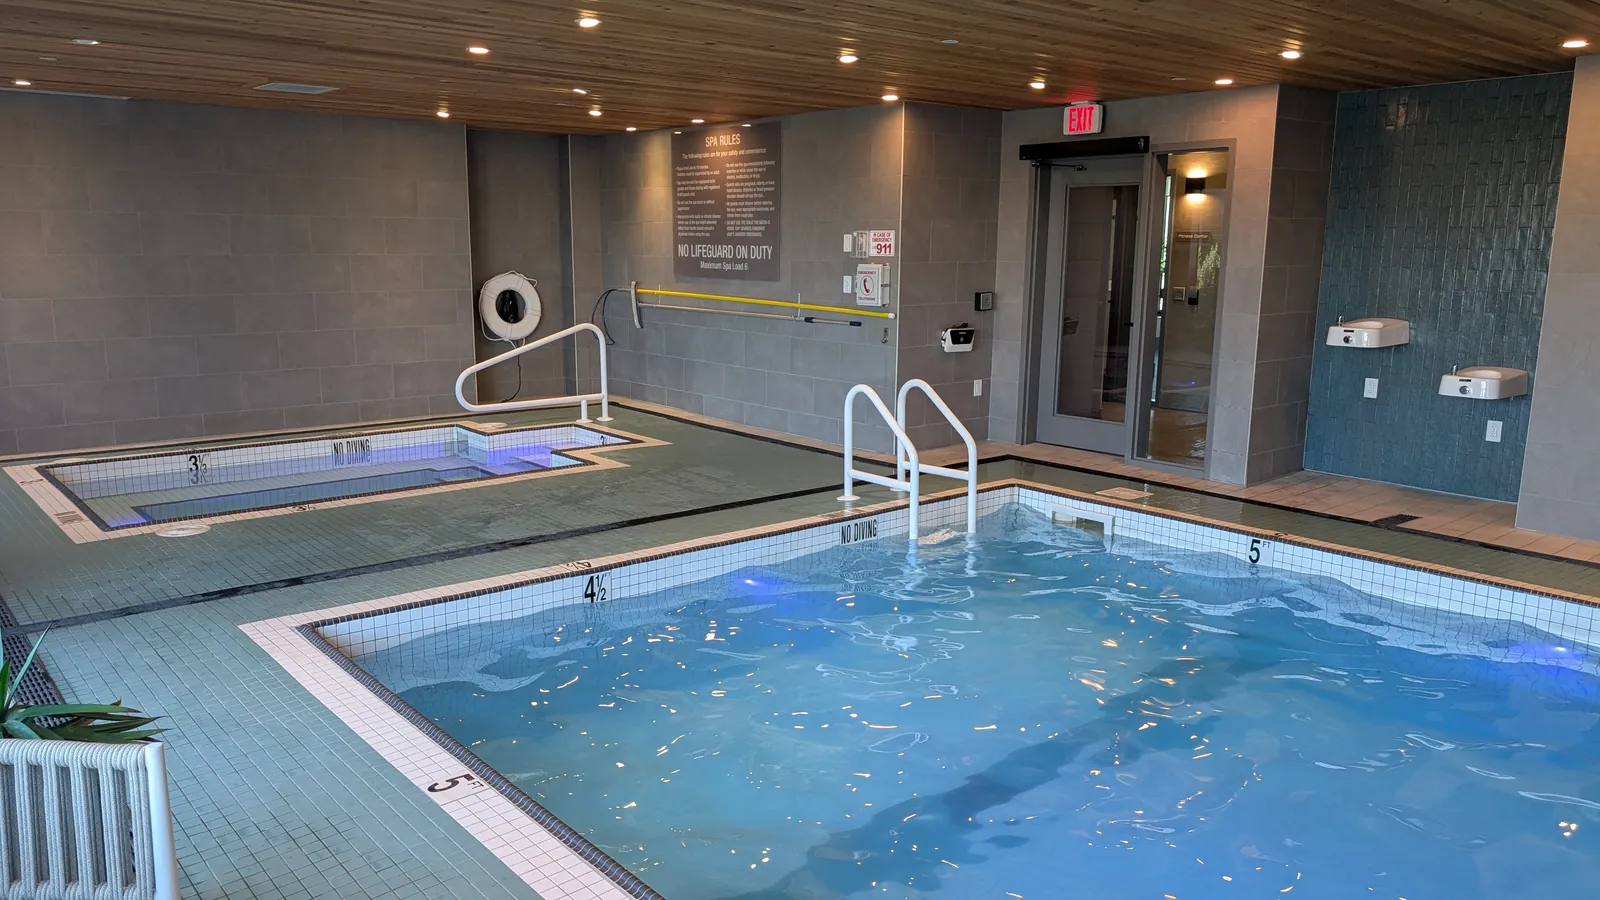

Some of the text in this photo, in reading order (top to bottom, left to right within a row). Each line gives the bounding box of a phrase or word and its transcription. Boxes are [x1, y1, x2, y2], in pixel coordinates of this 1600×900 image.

[1068, 106, 1095, 132] EXIT
[705, 133, 741, 148] SPA RULES
[678, 244, 773, 260] NO LIFEGUARD ON DUTY
[876, 243, 892, 254] 911
[700, 261, 748, 271] Maximum Spa Load 6
[333, 441, 344, 454] NO
[841, 519, 877, 545] NO DIVING
[1248, 539, 1261, 564] 5
[427, 773, 484, 793] 5 FT
